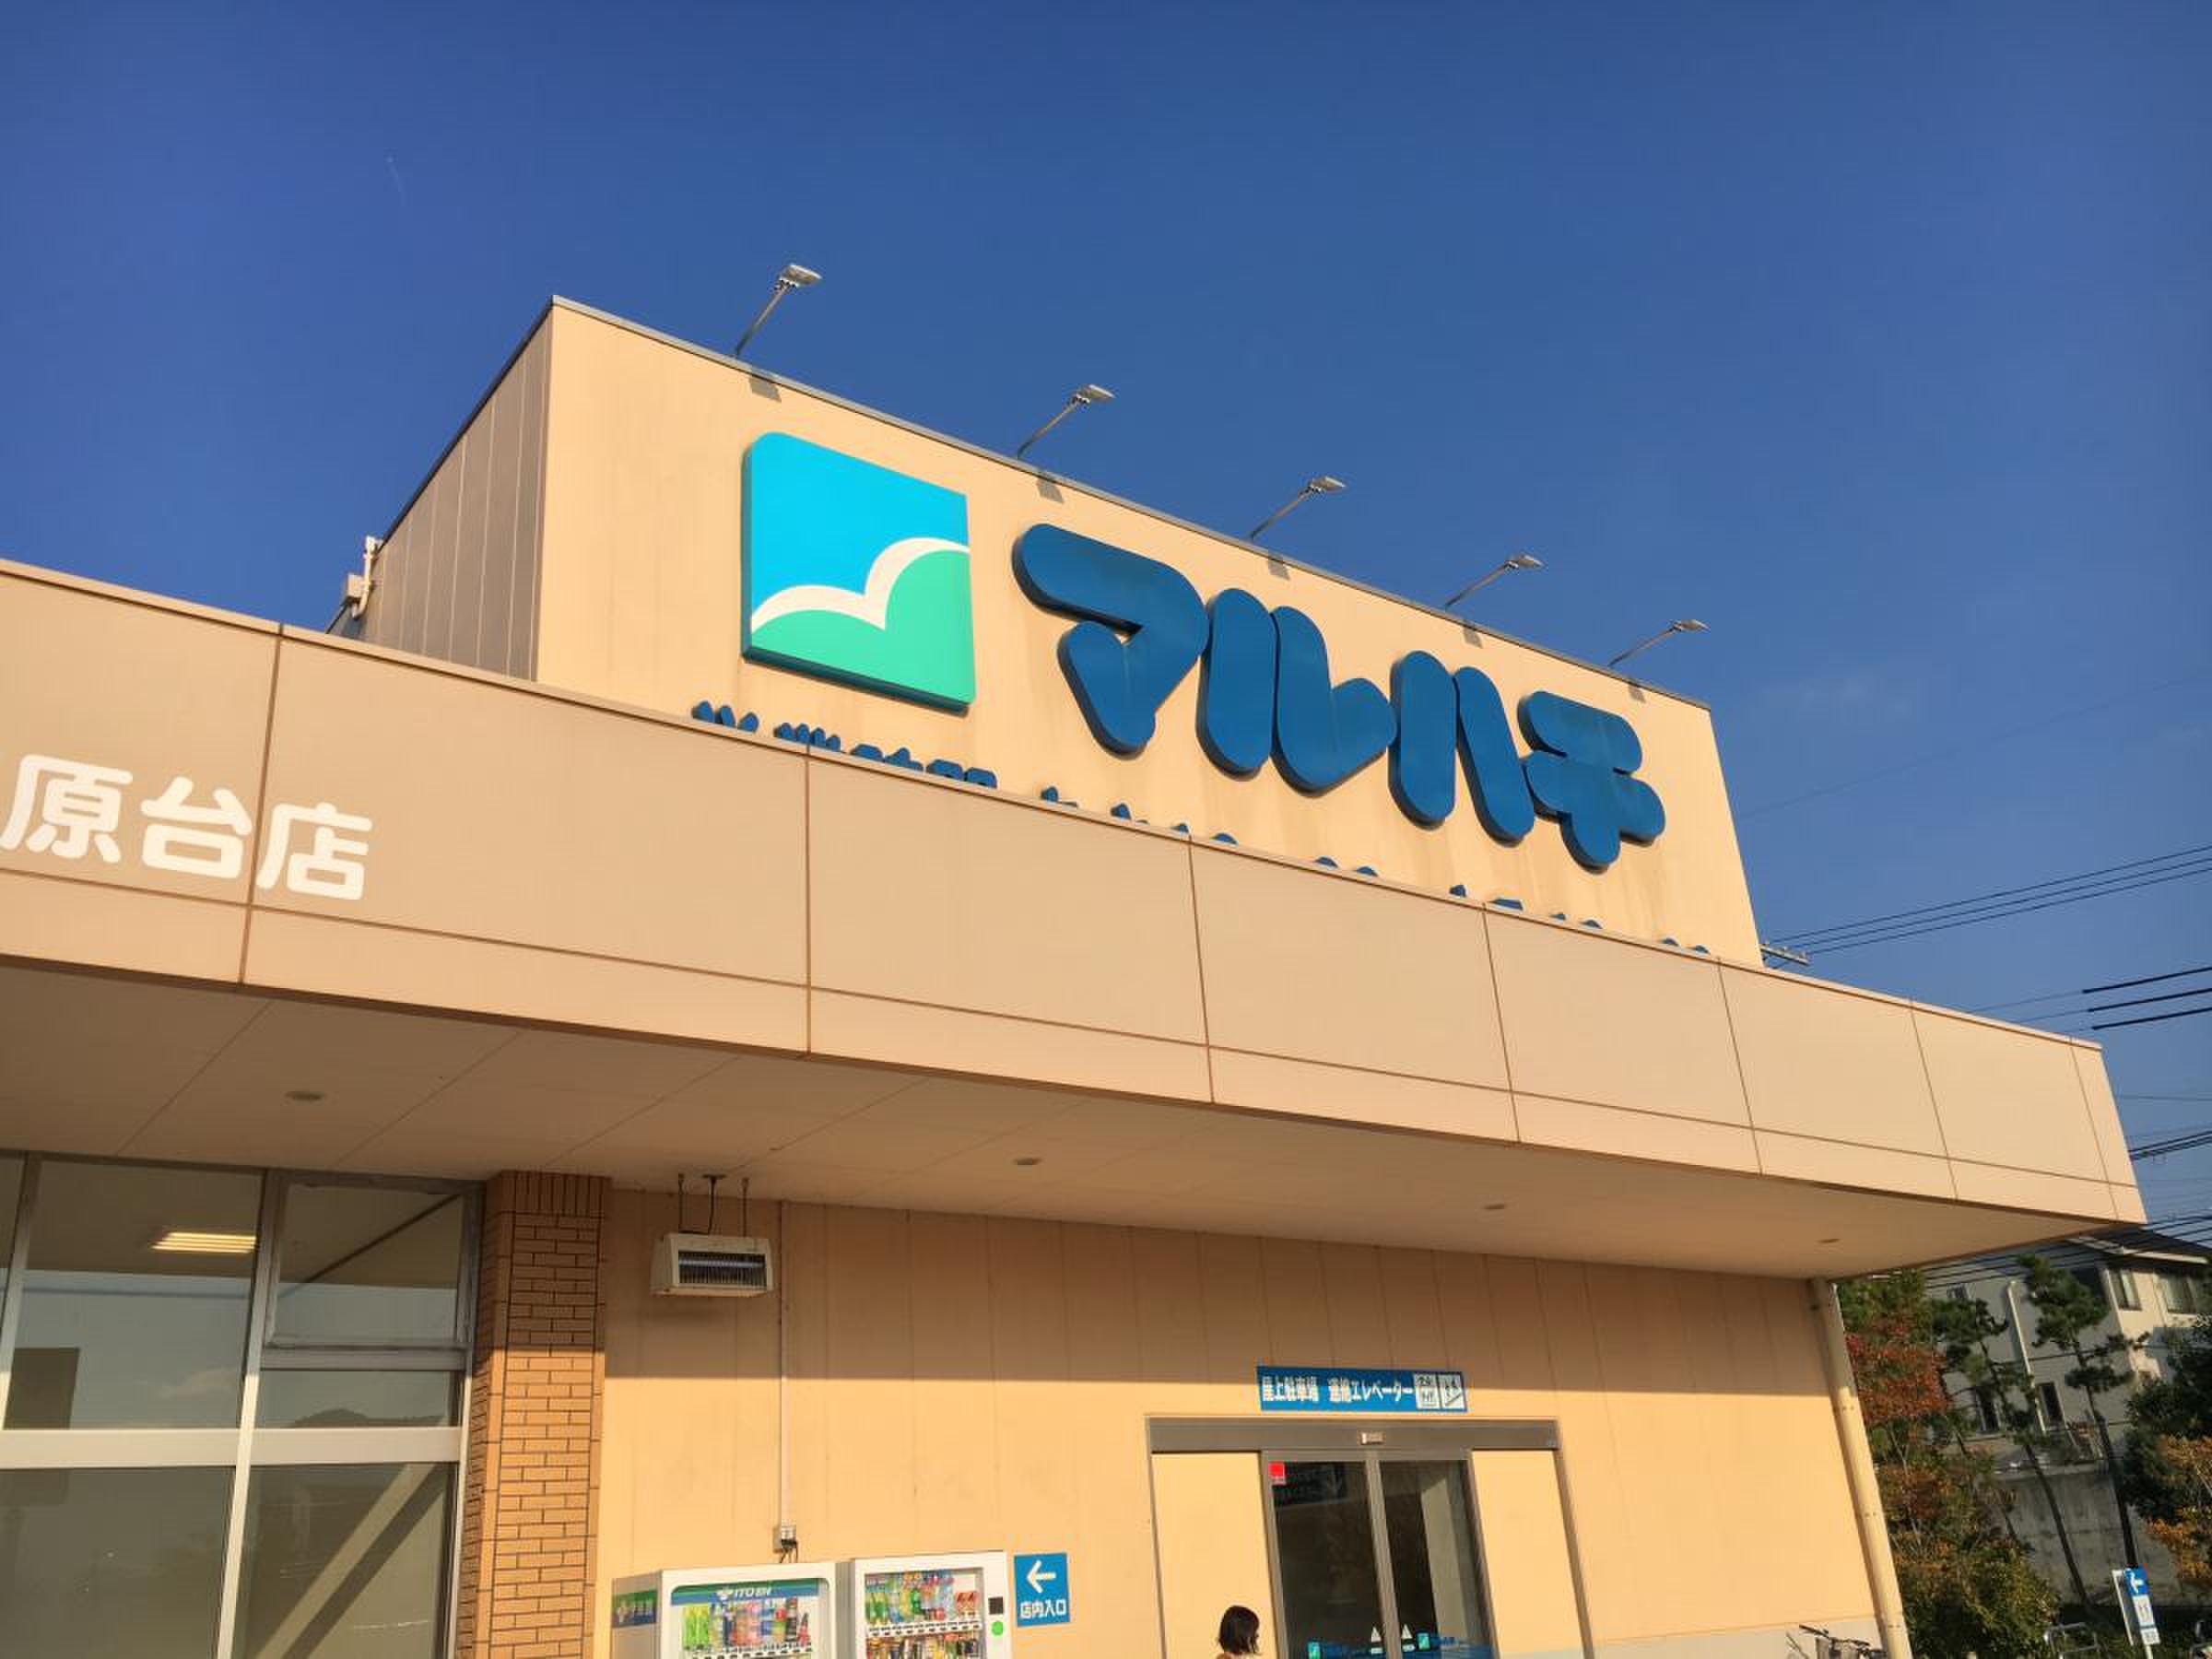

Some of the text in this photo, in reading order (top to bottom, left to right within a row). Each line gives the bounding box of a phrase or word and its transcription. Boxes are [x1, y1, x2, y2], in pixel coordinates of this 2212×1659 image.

[1012, 523, 1665, 872] マルハチ
[0, 754, 373, 900] 原台店
[1020, 1599, 1066, 1618] 店内入口
